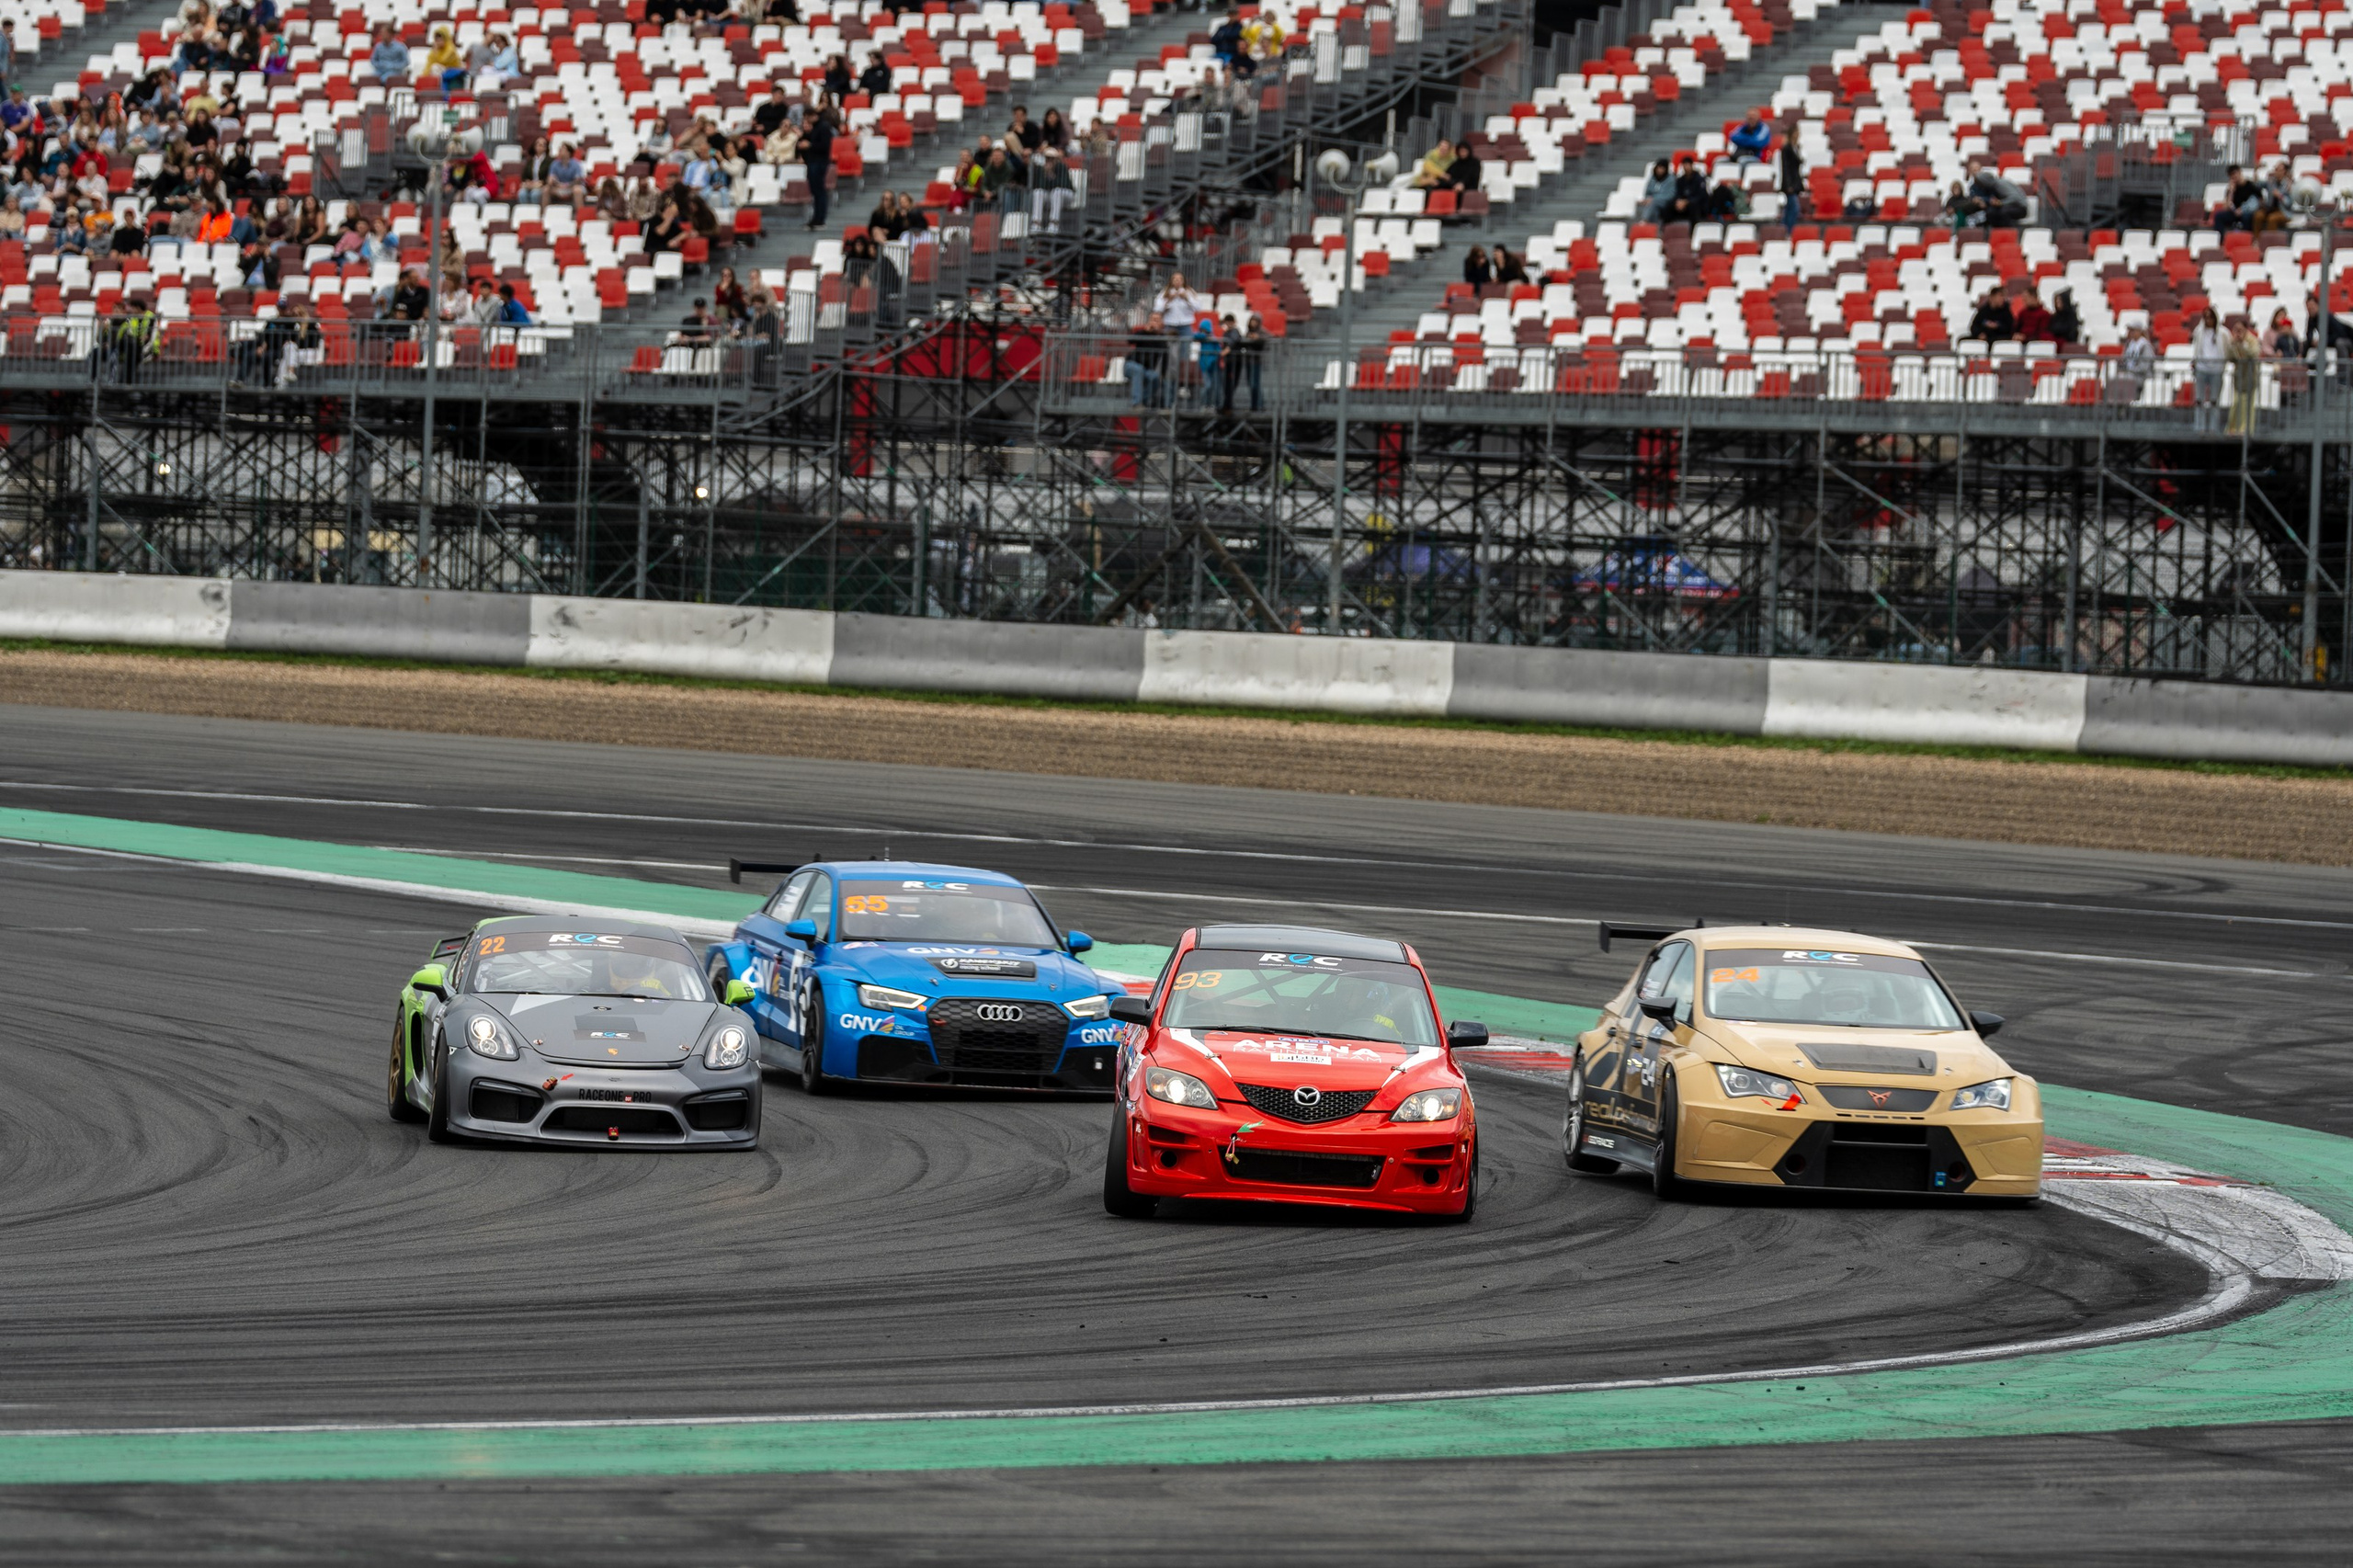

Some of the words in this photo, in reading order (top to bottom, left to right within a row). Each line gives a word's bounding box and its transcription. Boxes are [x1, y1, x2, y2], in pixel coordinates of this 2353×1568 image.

[845, 895, 889, 913] 55
[479, 936, 506, 955] 22
[1173, 971, 1222, 990] 93
[1711, 968, 1760, 983] 24
[839, 1013, 883, 1031] GNV
[1081, 1028, 1114, 1044] GNV
[1233, 1039, 1381, 1058] ARENA
[1233, 1046, 1315, 1055] RACING
[1328, 1050, 1382, 1063] TEAM
[578, 1088, 624, 1102] RACEONE
[632, 1091, 652, 1103] PRO
